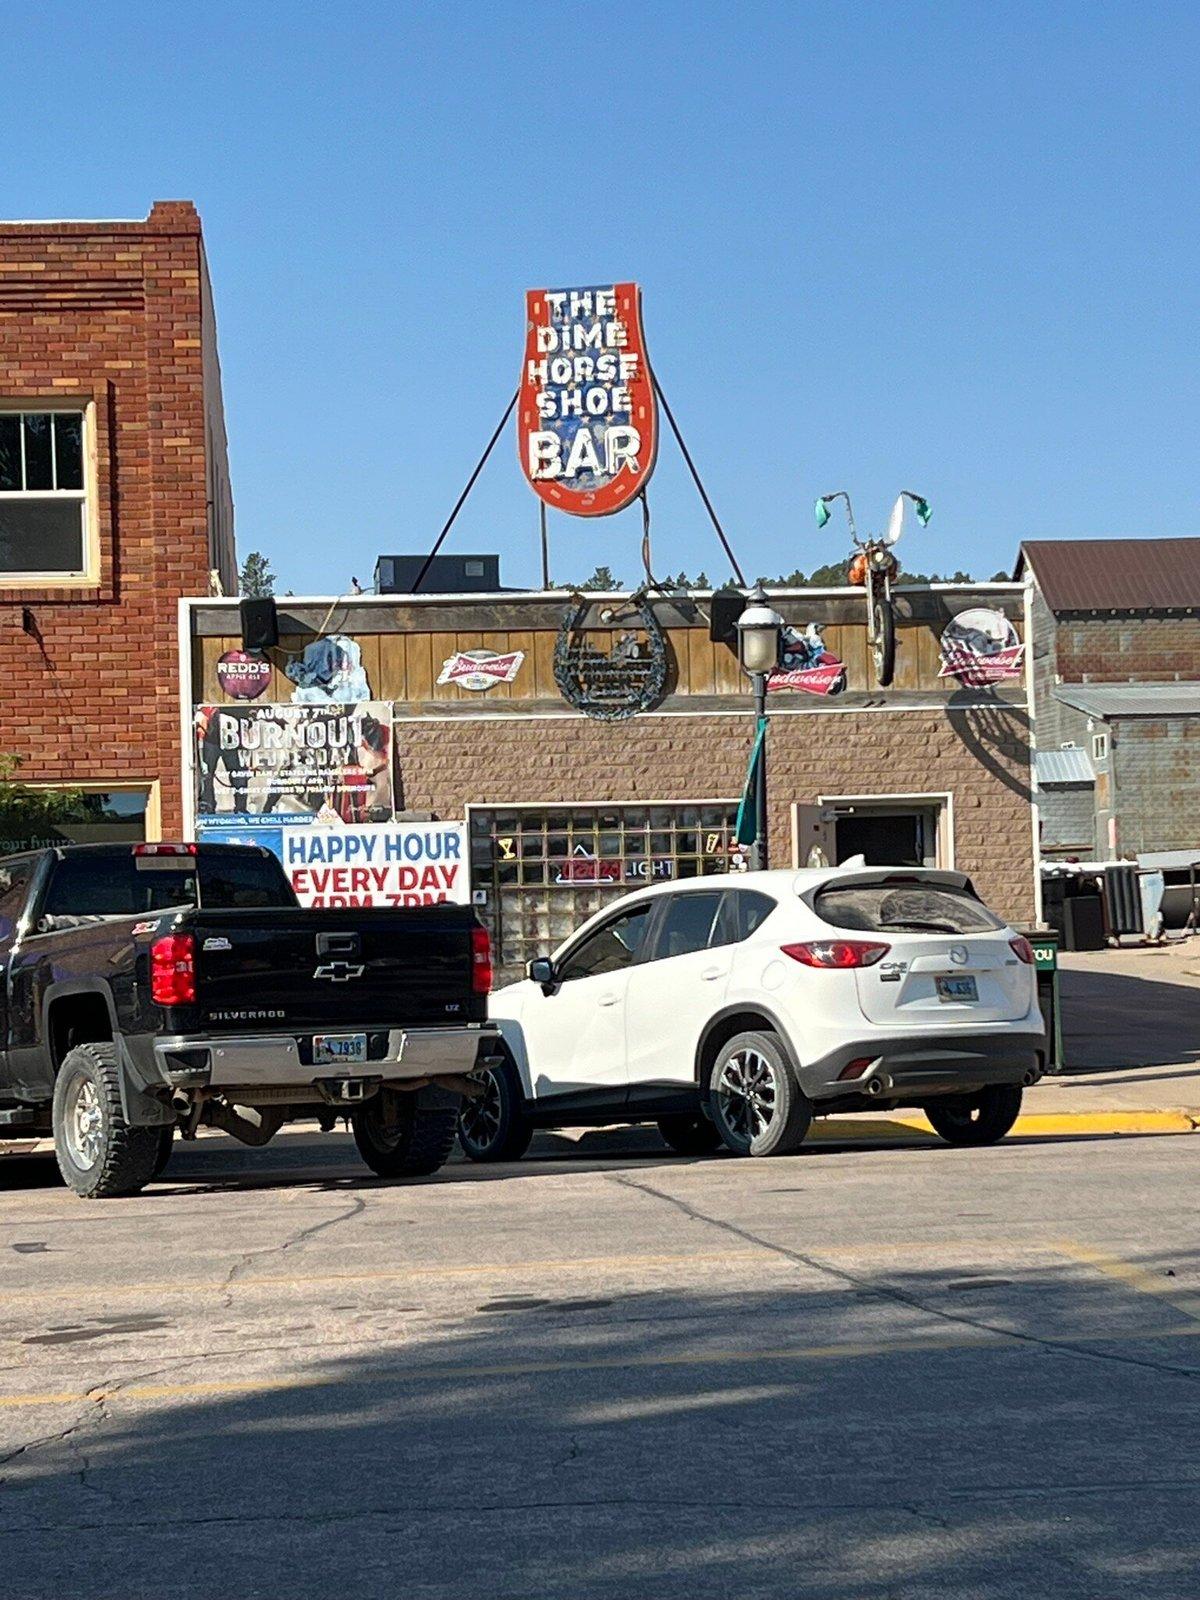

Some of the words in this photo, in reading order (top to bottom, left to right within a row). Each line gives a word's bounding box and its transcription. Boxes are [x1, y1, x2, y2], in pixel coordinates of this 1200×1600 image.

[544, 289, 616, 318] THE
[528, 353, 639, 386] HORSE
[536, 387, 632, 418] SHOE
[528, 425, 641, 479] BAR
[217, 661, 270, 674] REDD'S
[256, 708, 309, 719] AUGUST
[219, 713, 364, 750] BURNOUT
[238, 746, 351, 767] WEDNESDAY
[0, 839, 27, 851] our
[289, 833, 378, 864] HAPPY
[384, 832, 461, 861] HOUR
[290, 866, 390, 894] EVERY
[399, 864, 459, 890] DAY
[1032, 949, 1053, 961] OU
[209, 1010, 286, 1020] SILVERADO
